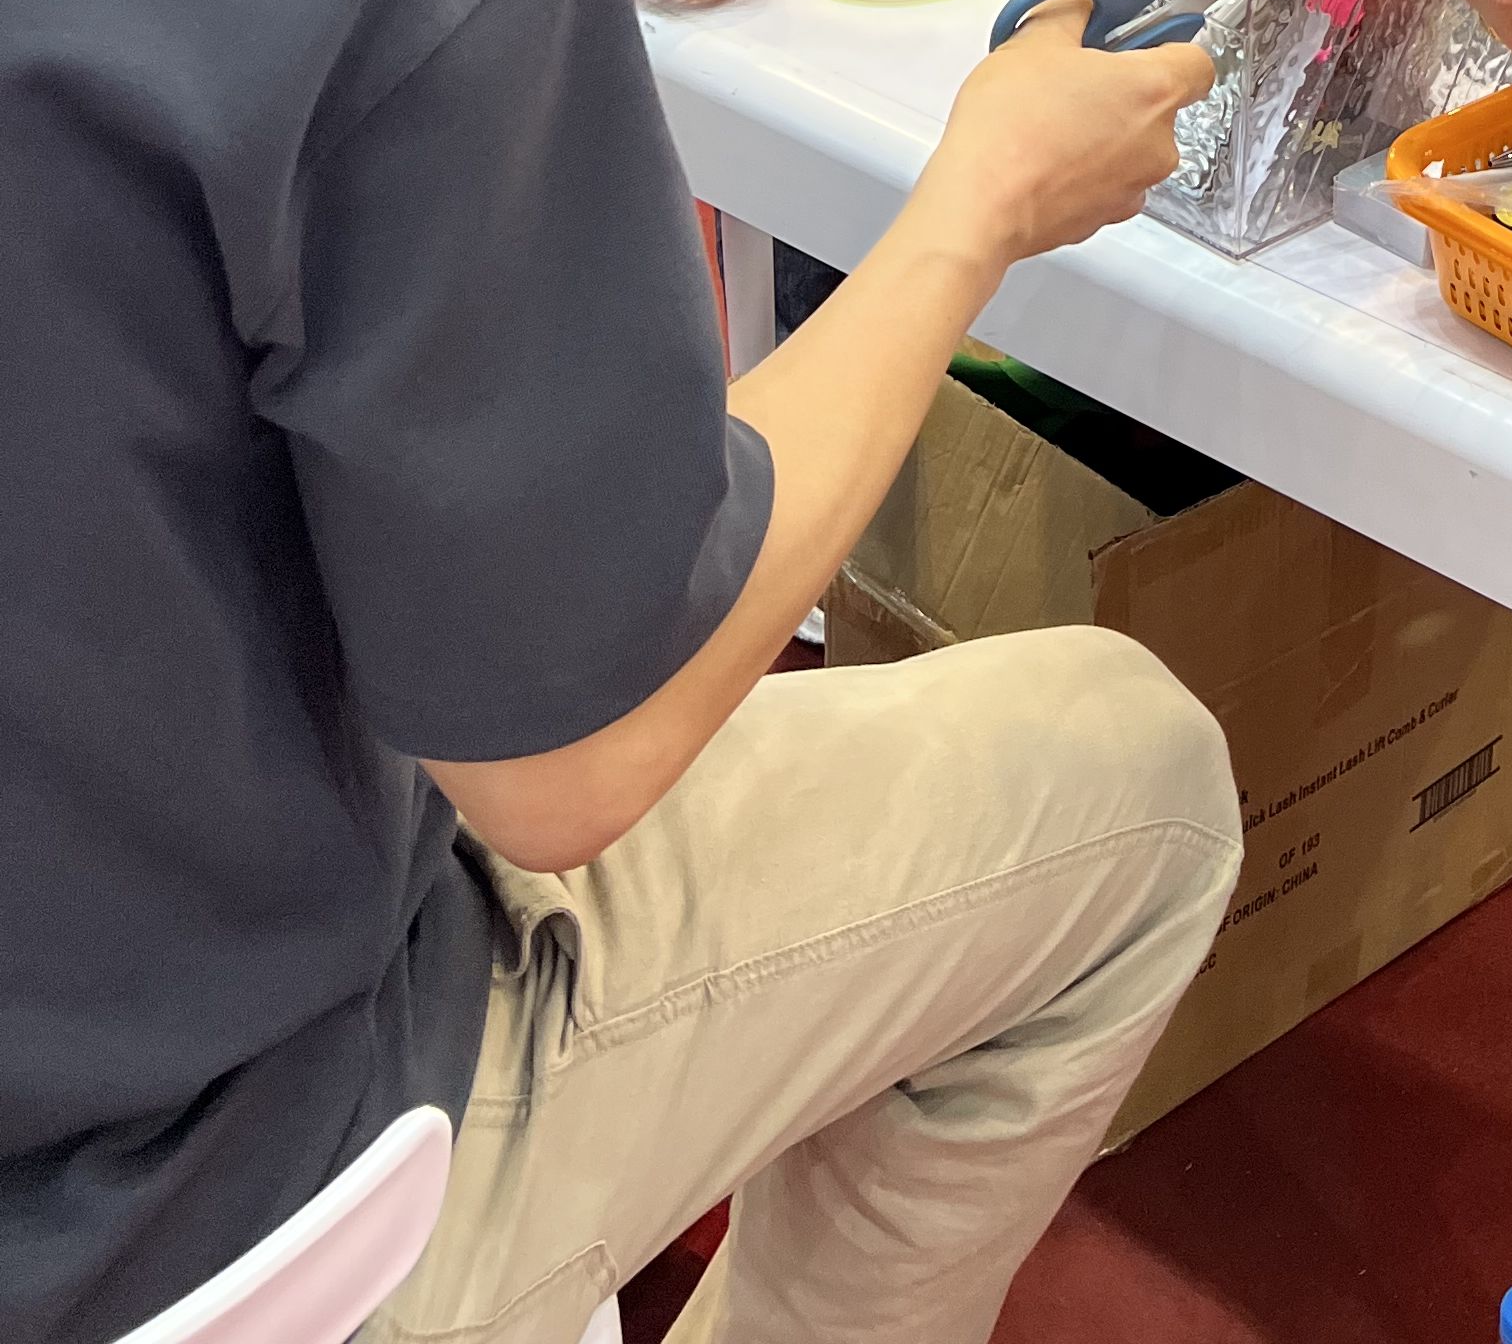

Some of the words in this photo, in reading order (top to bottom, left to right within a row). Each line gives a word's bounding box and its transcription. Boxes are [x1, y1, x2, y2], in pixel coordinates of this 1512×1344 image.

[1269, 792, 1297, 818] Lash
[1299, 766, 1338, 801] Instant
[1339, 748, 1366, 776] Lash
[1367, 734, 1386, 758] Lift
[1387, 716, 1417, 745] Comb
[1418, 708, 1426, 725] &
[1428, 687, 1460, 718] Curler
[1279, 847, 1296, 869] OF
[1302, 832, 1320, 856] 193
[1233, 887, 1279, 925] ORIGIN:
[1281, 862, 1319, 896] CHINA
